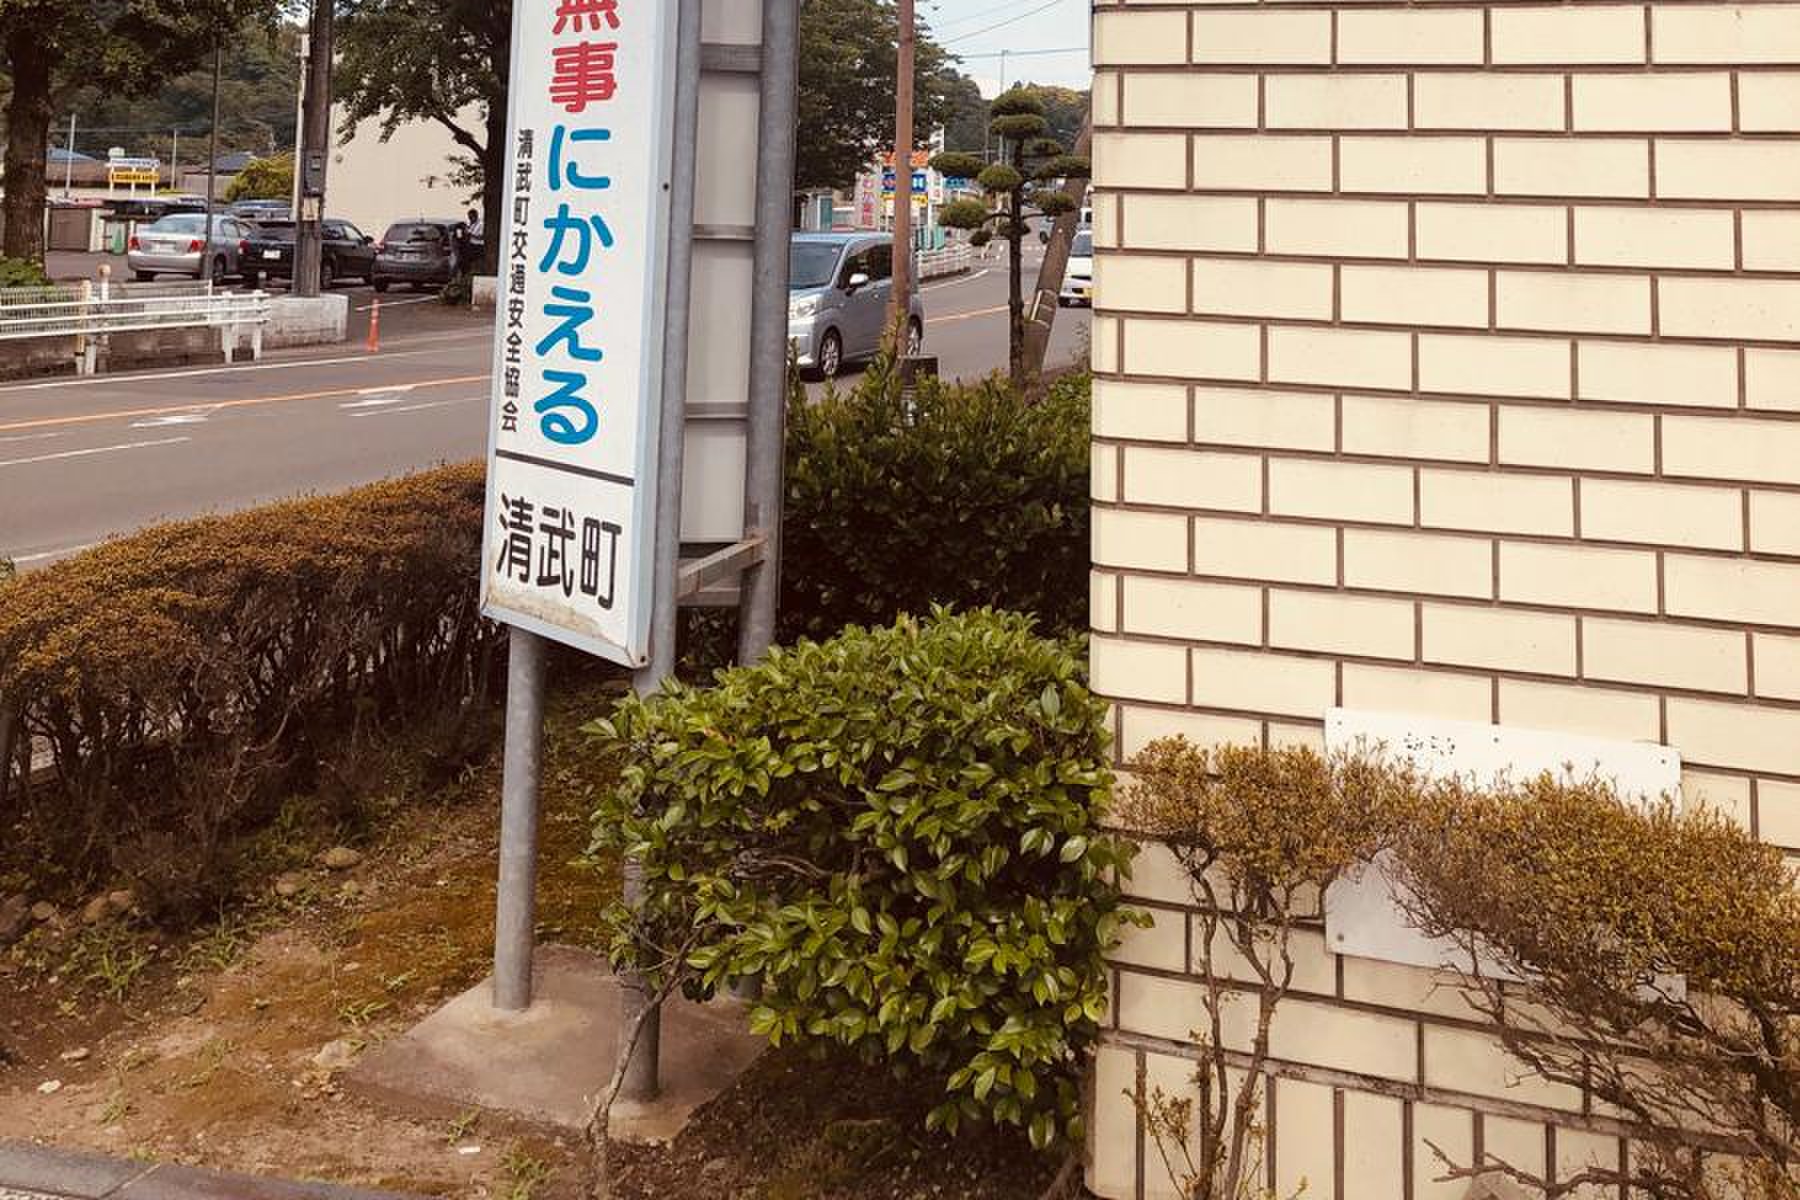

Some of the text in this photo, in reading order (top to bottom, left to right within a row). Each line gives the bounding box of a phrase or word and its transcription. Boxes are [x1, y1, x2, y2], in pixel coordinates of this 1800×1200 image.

[501, 128, 534, 433] 清武町交通安全協会
[496, 493, 621, 610] 清武町
